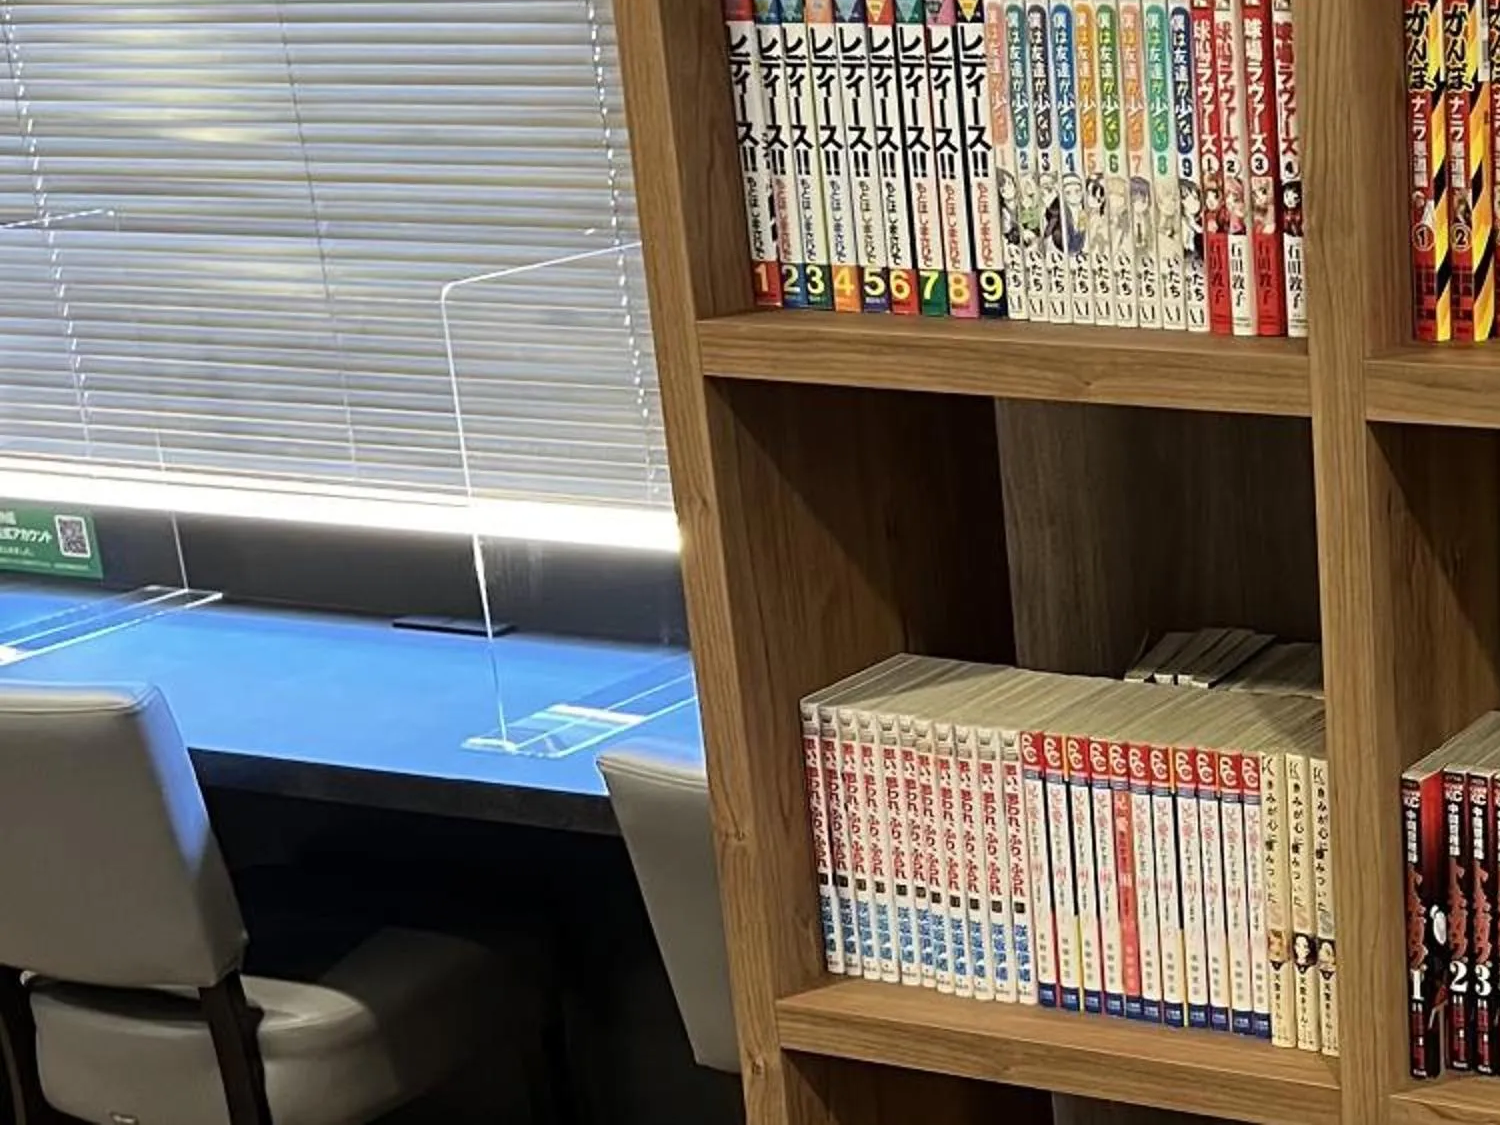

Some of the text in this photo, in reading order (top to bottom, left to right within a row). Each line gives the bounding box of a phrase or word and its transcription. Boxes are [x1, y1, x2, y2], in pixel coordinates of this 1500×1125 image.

[754, 263, 769, 292] 1
[784, 265, 799, 292] 2
[807, 264, 824, 293] 3
[835, 264, 852, 295] 4
[864, 267, 886, 296] 5
[890, 270, 910, 298] 6
[922, 272, 940, 299] 7
[950, 272, 969, 300] 8
[981, 272, 1003, 300] 9
[1411, 969, 1424, 1001] 1
[1450, 962, 1468, 992] 2
[1475, 965, 1491, 996] 3
